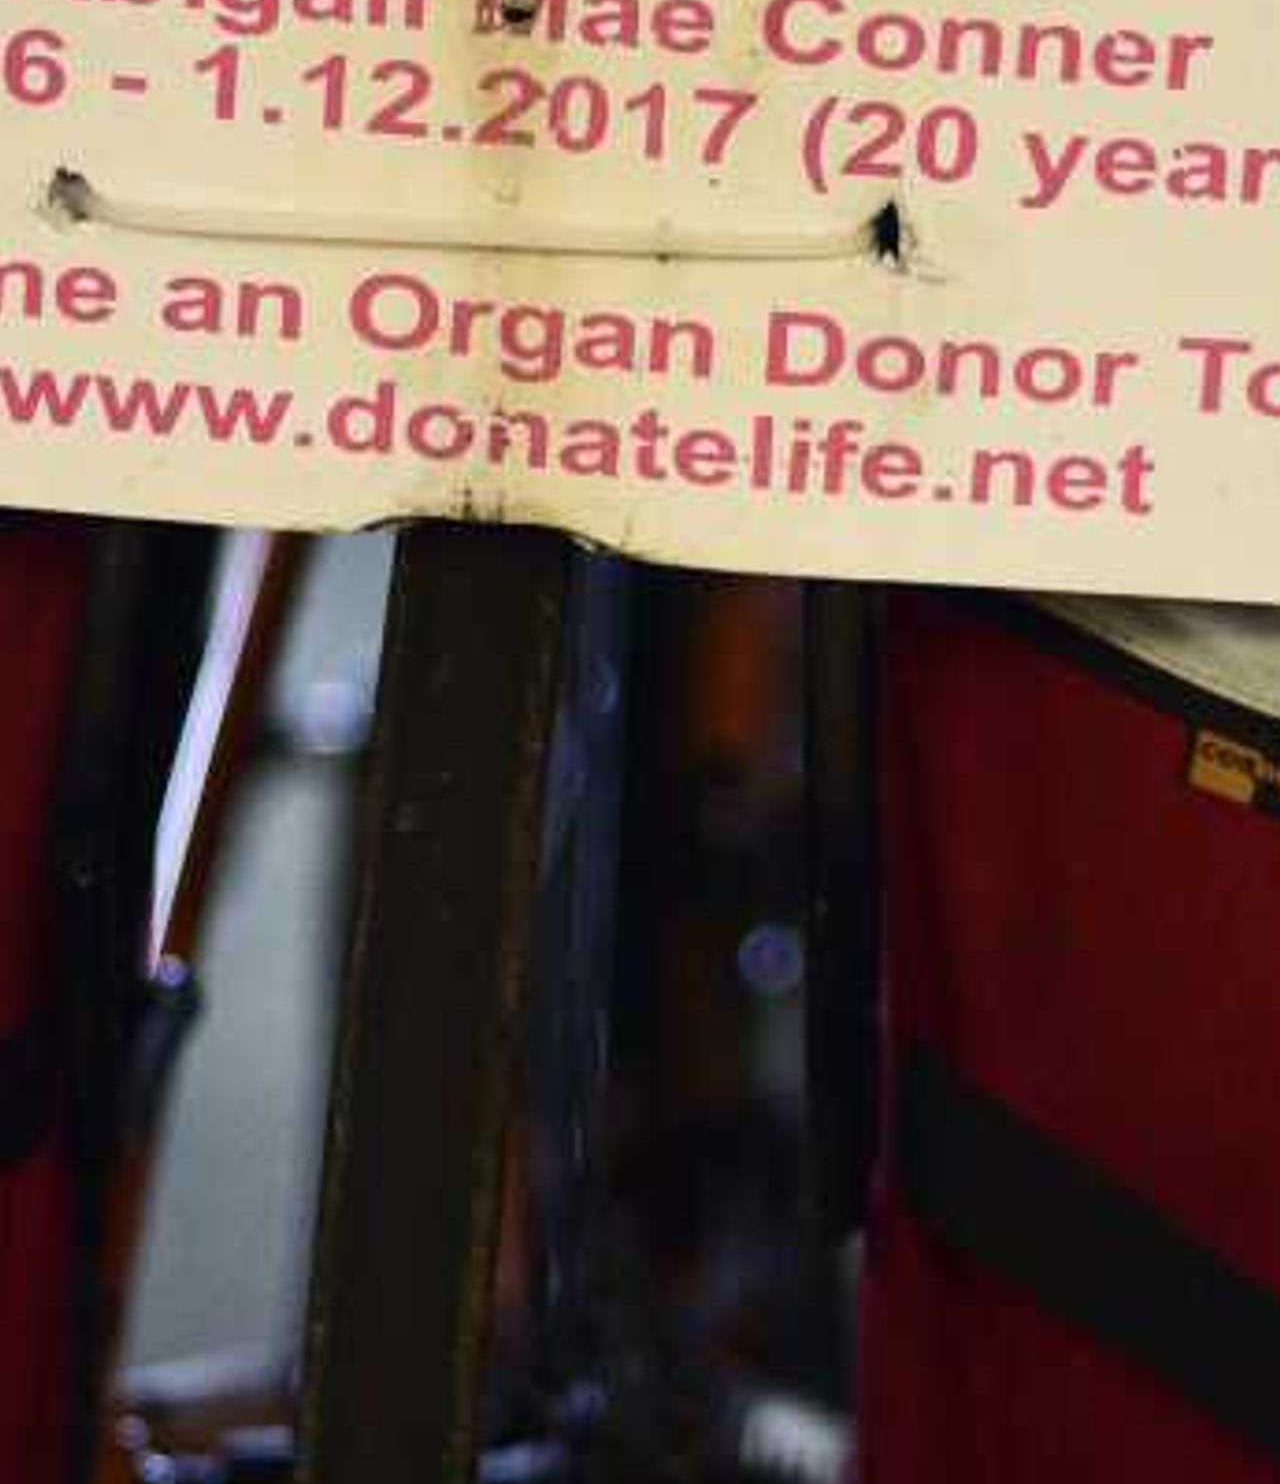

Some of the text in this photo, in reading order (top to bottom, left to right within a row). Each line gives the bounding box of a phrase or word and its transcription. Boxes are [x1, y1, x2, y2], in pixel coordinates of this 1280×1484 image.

[194, 47, 757, 165] 1.12.2017
[800, 96, 978, 192] (20
[163, 276, 302, 341] an
[349, 274, 713, 382] Organ
[764, 311, 1138, 407] Donor
